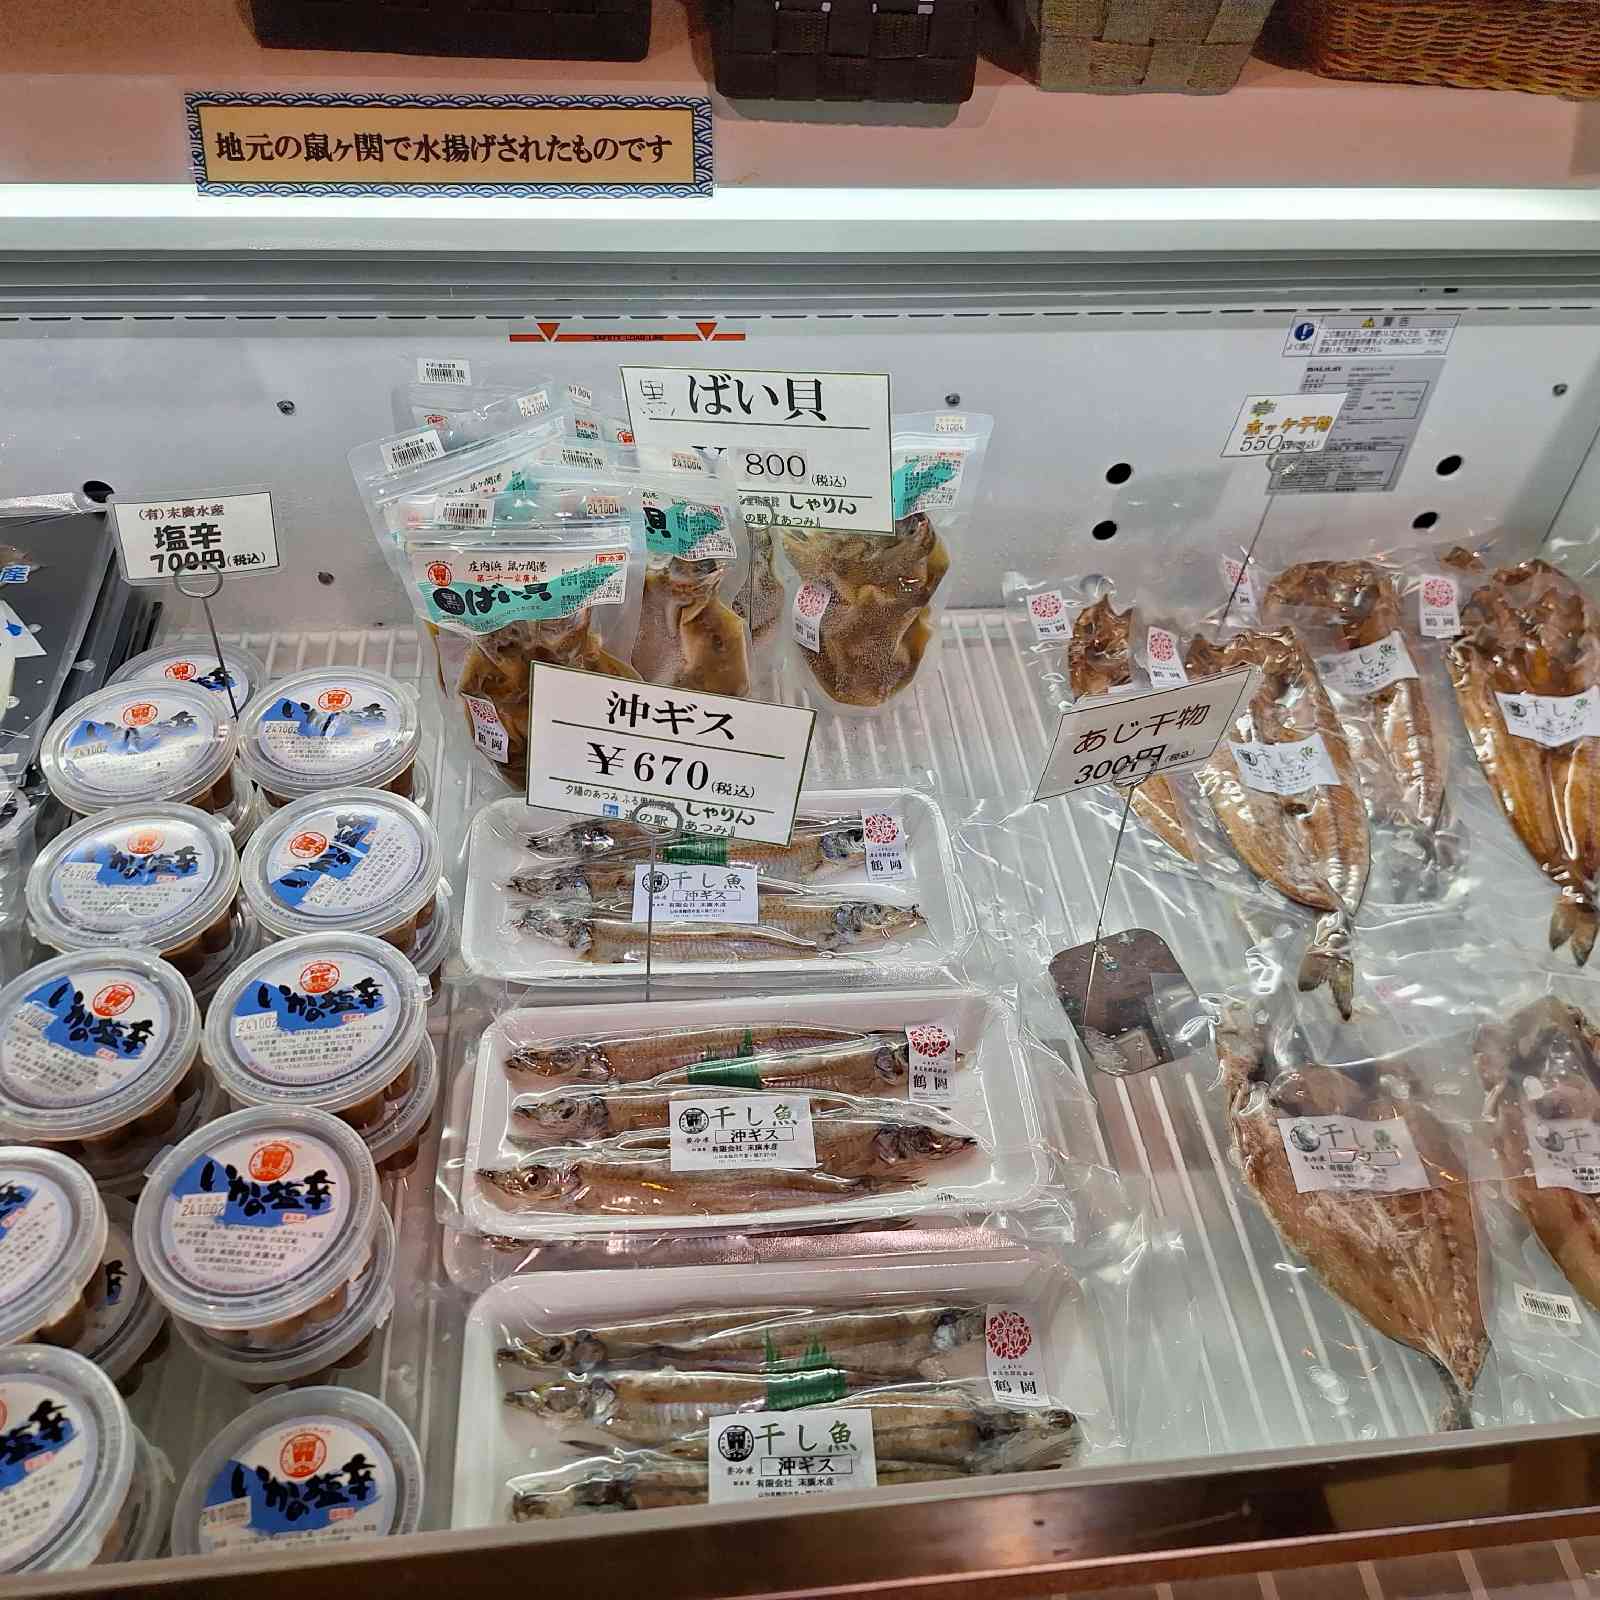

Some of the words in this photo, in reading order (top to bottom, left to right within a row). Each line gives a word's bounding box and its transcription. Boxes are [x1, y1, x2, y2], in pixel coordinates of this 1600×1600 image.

[214, 130, 673, 163] 地元の鼠ヶ関で水揚げされたものです
[745, 453, 806, 477] 800
[789, 494, 857, 515] しゃりん
[153, 522, 222, 552] 塩辛
[605, 689, 735, 740] 沖ギス
[1072, 703, 1211, 755] あじ干物
[685, 800, 756, 826] しゃりん
[670, 871, 745, 890] 干し魚
[709, 1103, 798, 1129] 干し魚
[729, 1129, 779, 1143] 沖ギス
[993, 1379, 1038, 1395] 鶴岡
[754, 1420, 858, 1456] 干し魚
[777, 1456, 836, 1476] 沖ギス
